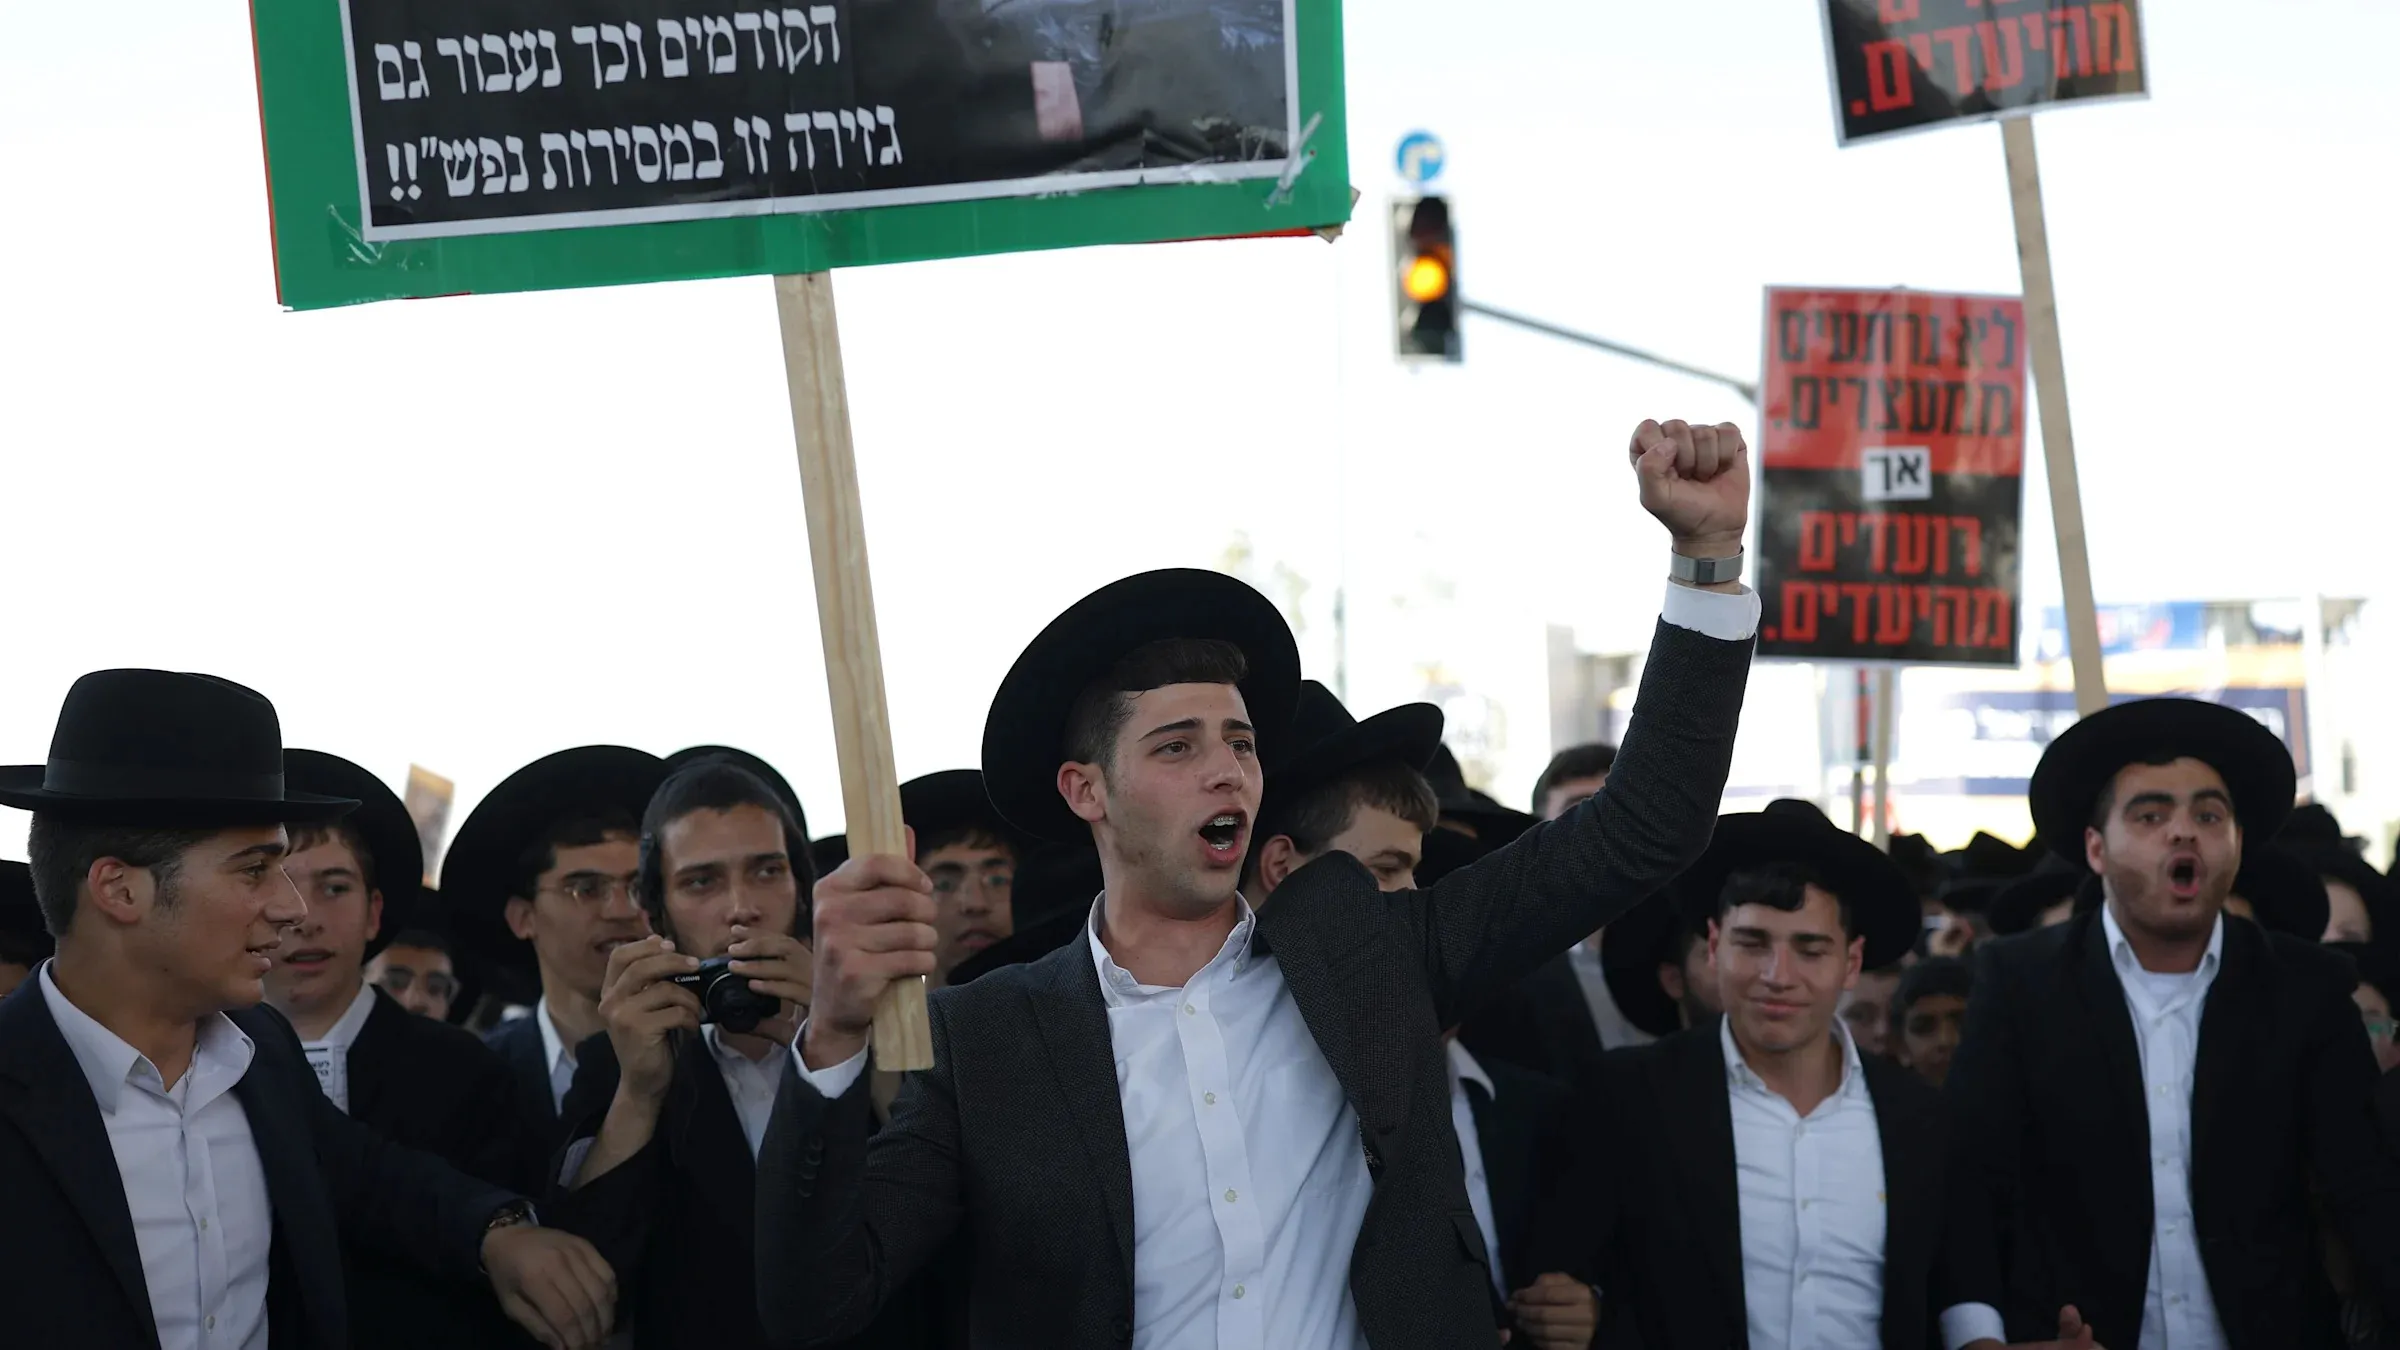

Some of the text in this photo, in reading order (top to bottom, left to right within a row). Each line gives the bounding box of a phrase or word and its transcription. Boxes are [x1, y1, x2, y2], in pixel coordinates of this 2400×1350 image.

[375, 4, 840, 100] הקודמים וכך נעבור גם
[1851, 3, 2136, 116] מהיעדים.
[540, 120, 724, 190] במסירות
[733, 115, 771, 175] זו
[784, 104, 903, 172] גזירה
[1778, 307, 2015, 369] לא נרתעים
[1773, 375, 2013, 436] ממעצרים.
[1869, 454, 1923, 492] אך
[1798, 511, 1983, 577] רועדים
[1764, 580, 2012, 649] מהיעדים.
[675, 975, 700, 983] Canon
